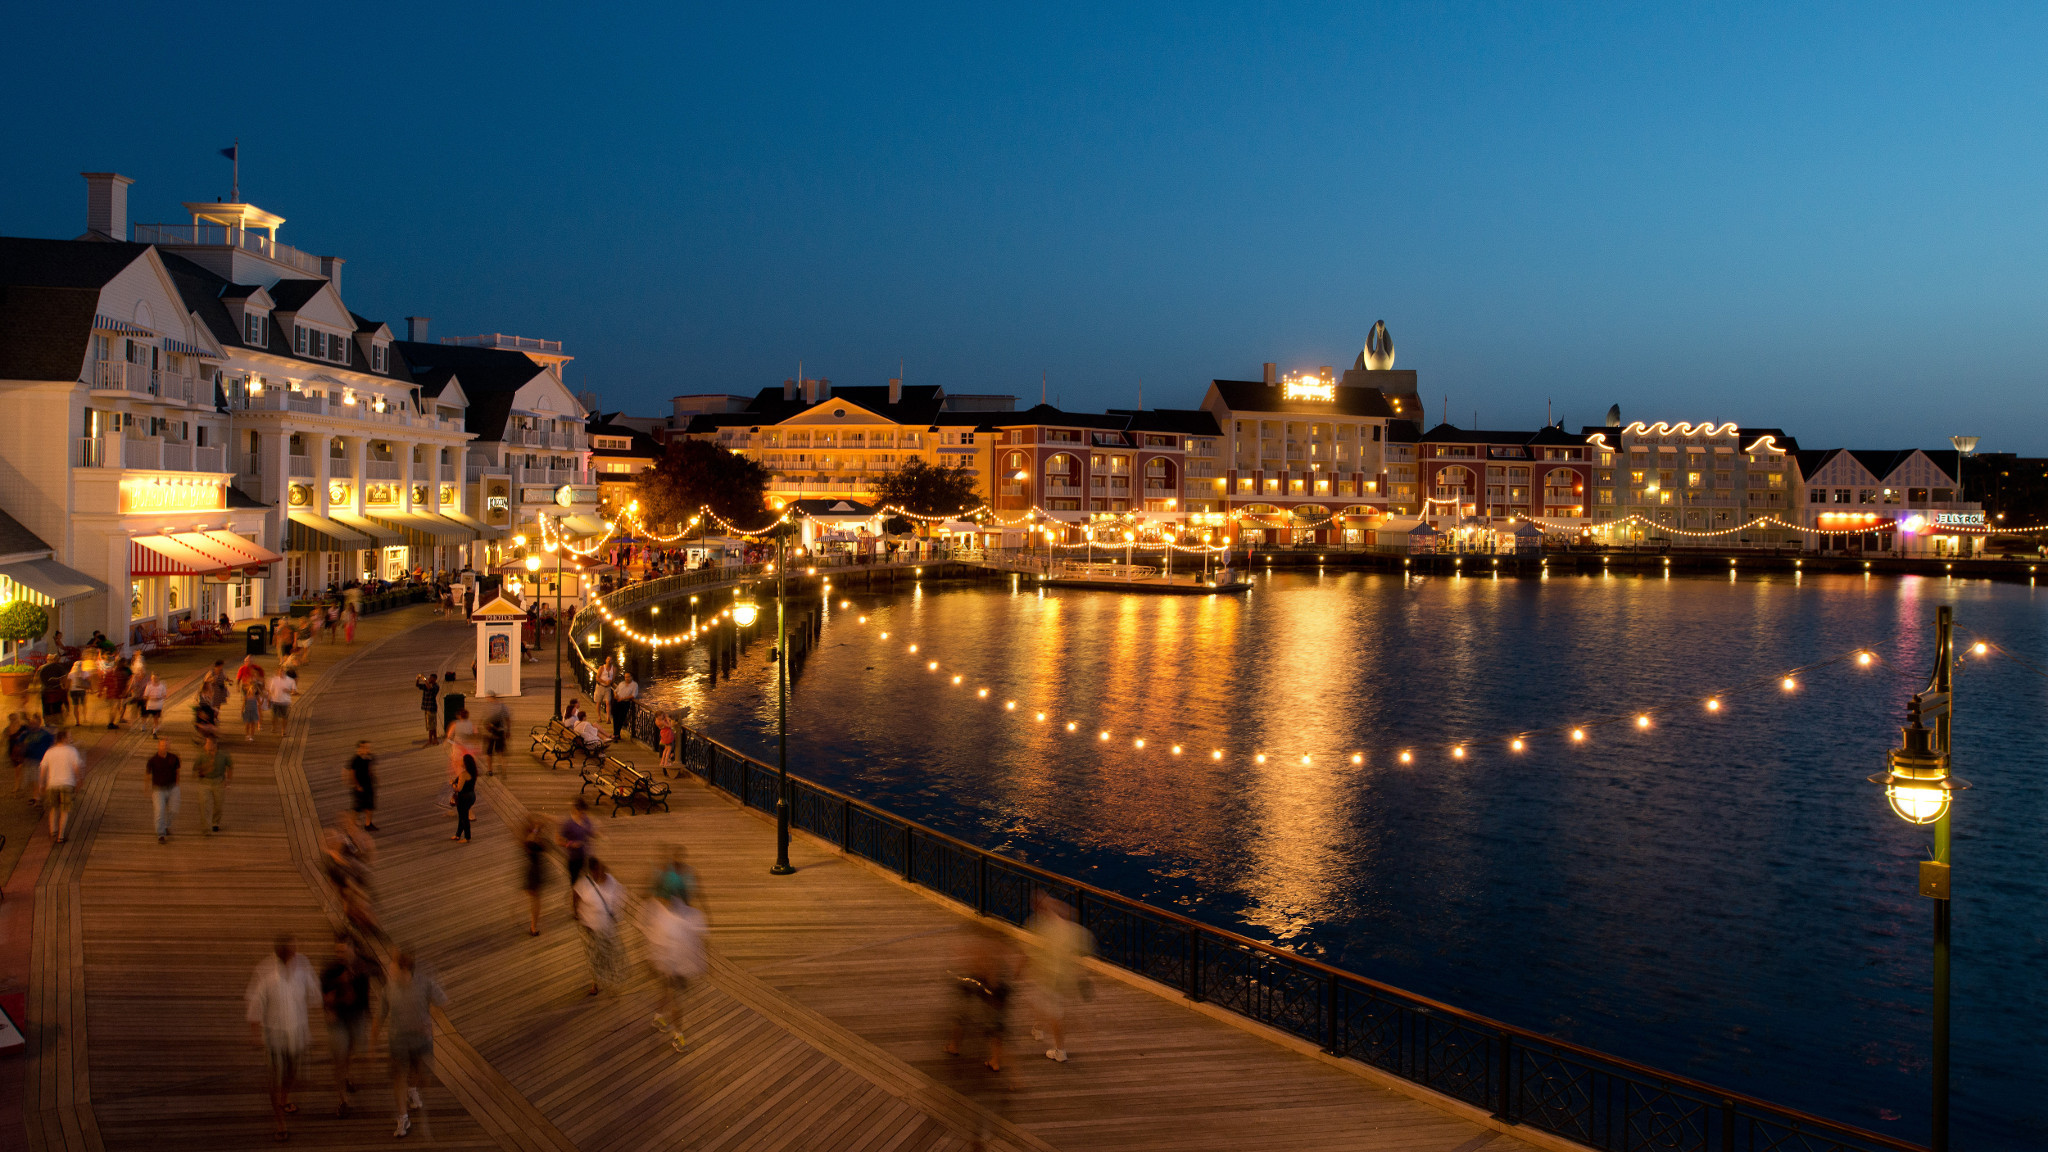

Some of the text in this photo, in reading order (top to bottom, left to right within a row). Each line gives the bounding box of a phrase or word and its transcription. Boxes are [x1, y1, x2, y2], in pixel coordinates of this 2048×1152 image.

[1633, 435, 1660, 445] Crest
[1675, 435, 1696, 445] The
[1697, 435, 1728, 446] Wave
